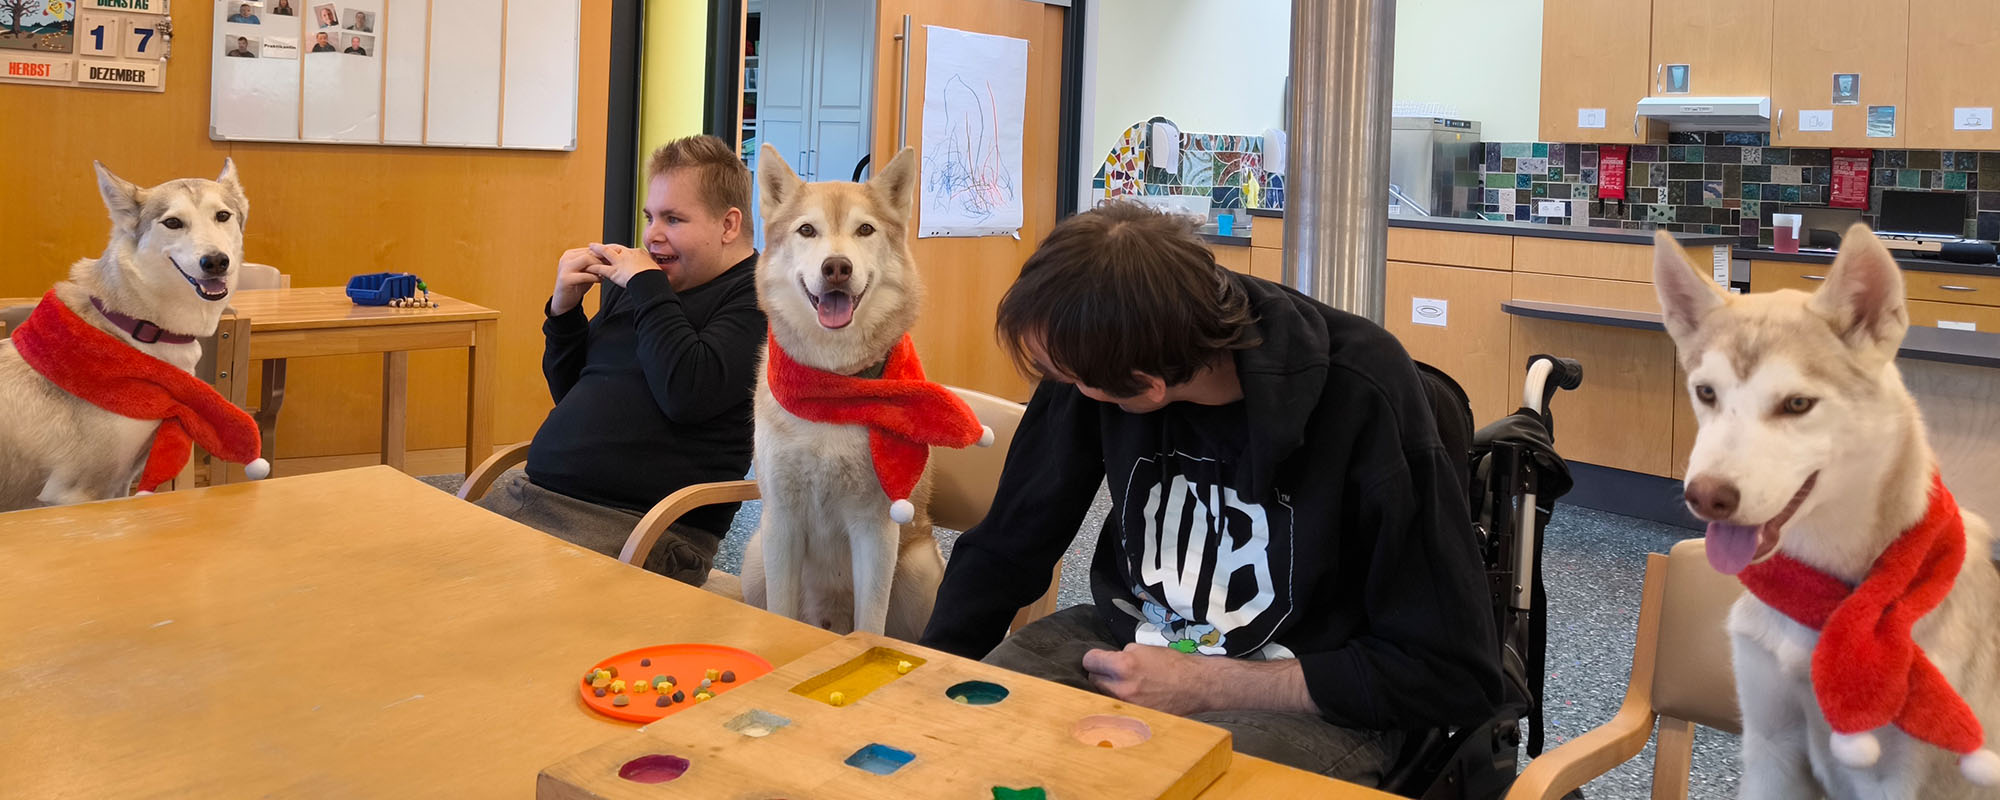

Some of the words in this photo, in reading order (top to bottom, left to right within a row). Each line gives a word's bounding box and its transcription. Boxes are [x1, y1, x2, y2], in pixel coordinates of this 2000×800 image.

[97, 0, 149, 10] DIENSTAG
[90, 25, 104, 50] 1
[134, 28, 154, 53] 7
[9, 62, 51, 77] HERBST
[90, 67, 146, 83] DEZEMBER
